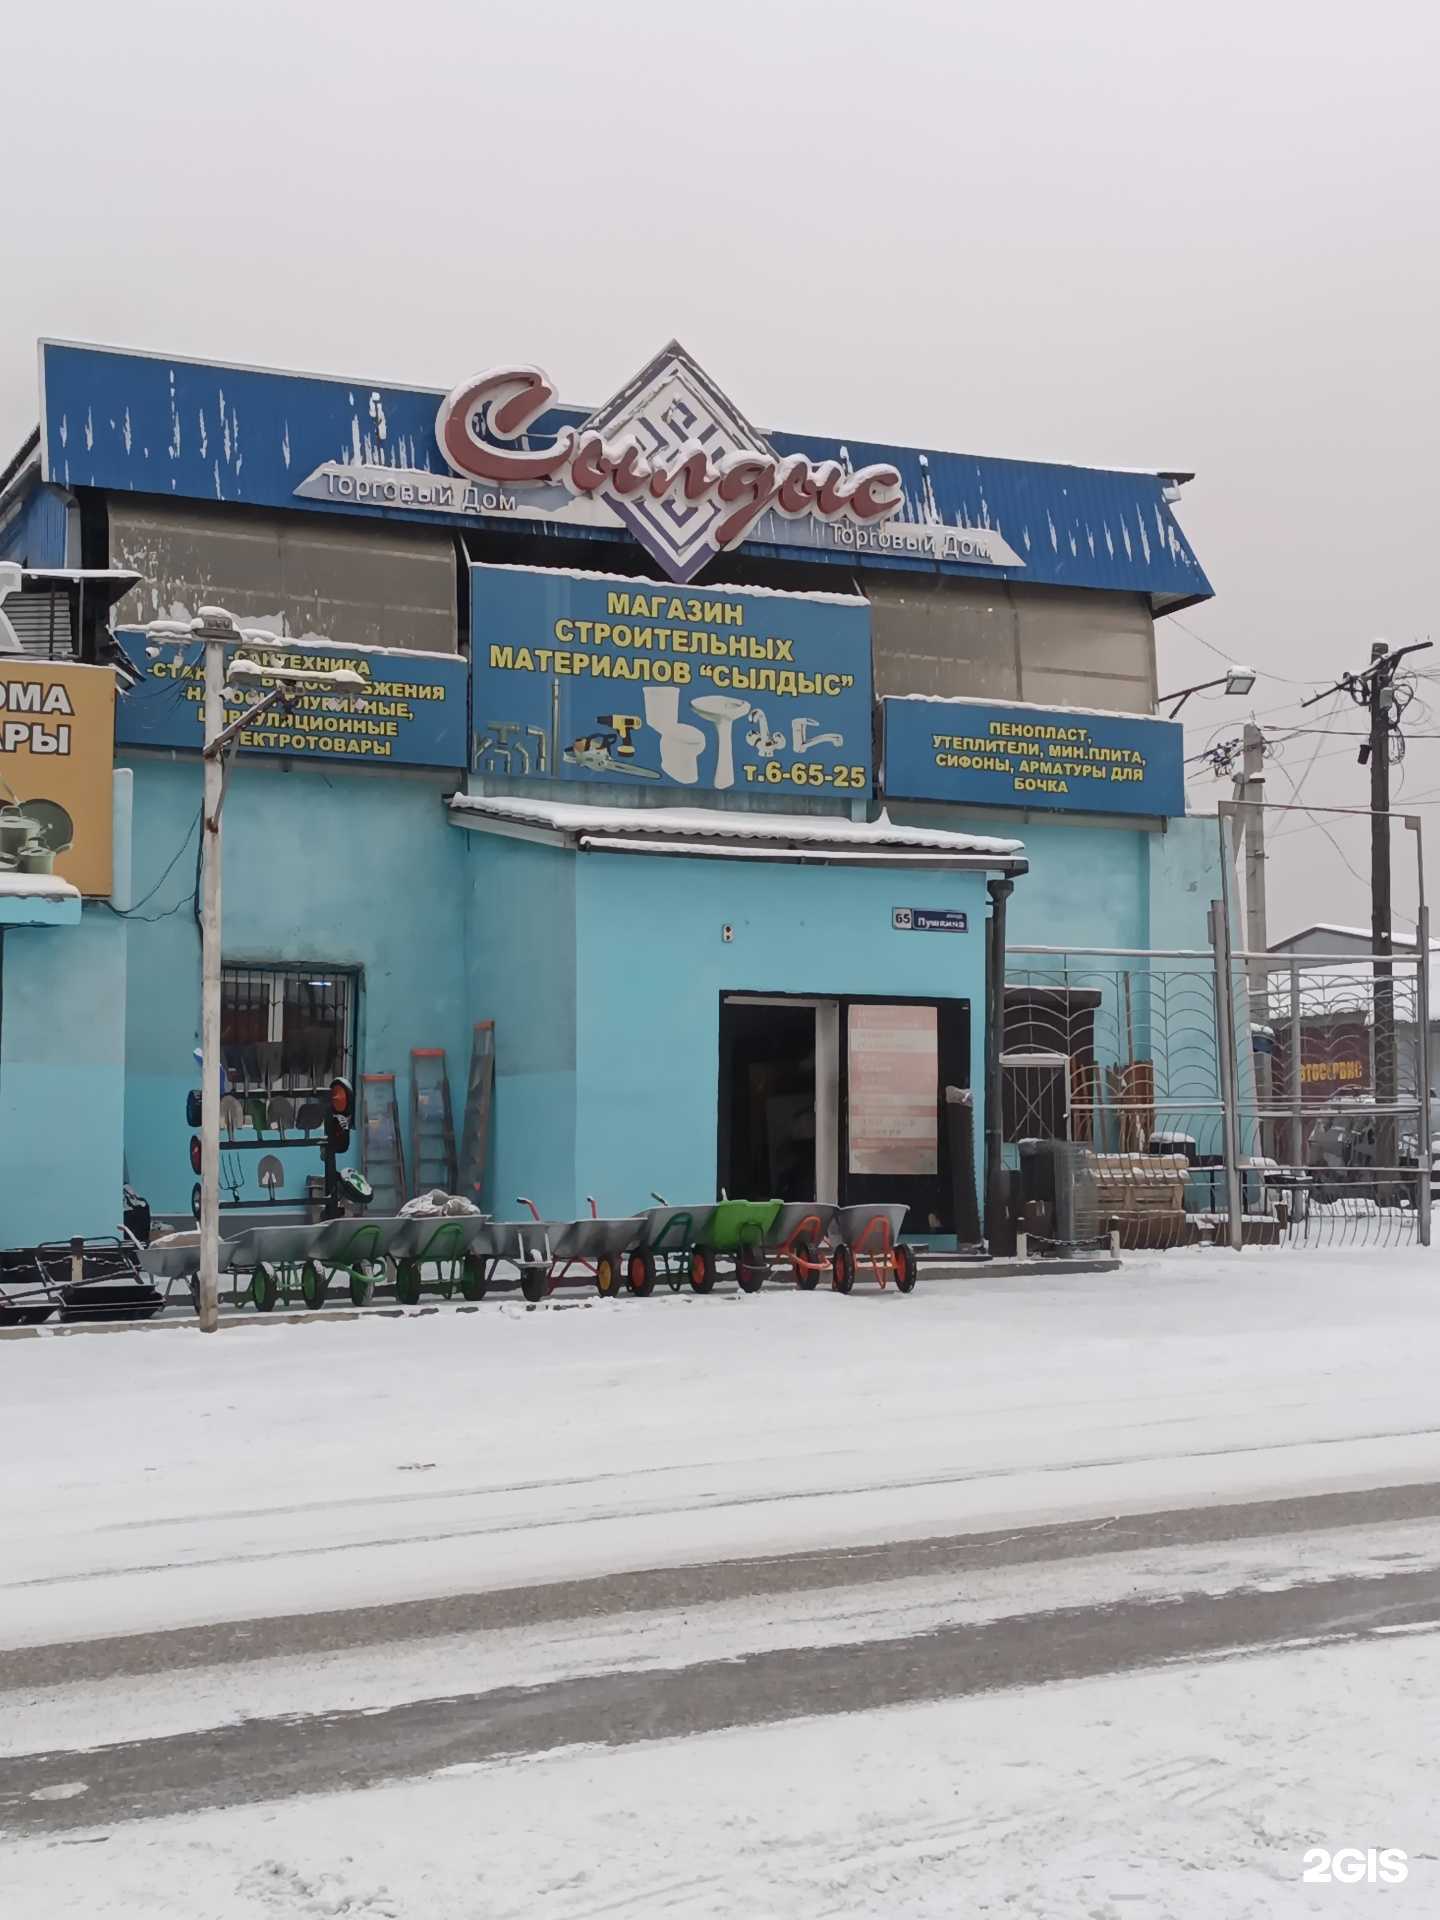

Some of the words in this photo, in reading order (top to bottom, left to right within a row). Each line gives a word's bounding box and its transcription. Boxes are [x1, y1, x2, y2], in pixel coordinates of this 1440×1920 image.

[323, 472, 455, 507] Торговый
[462, 486, 518, 513] Дом
[829, 523, 937, 554] Торговый
[943, 533, 992, 560] Дом
[606, 591, 744, 626] МАГАЗИН
[553, 619, 795, 662] СТРОИТЕЛЬНЫХ
[488, 644, 693, 685] МАТЕРИАЛОВ
[989, 721, 1093, 745] ПЕНОПЛАСТ,
[932, 734, 1045, 759] УТЕПЛИТЕЛИ,
[1048, 744, 1147, 767] МИН.ПЛИТА,
[935, 753, 1015, 775] СИФОНЫ,
[1018, 760, 1106, 780] АРМАТУРЫ
[1110, 767, 1144, 782] ДЛЯ
[1013, 776, 1070, 794] БОЧКА
[895, 913, 910, 924] 65
